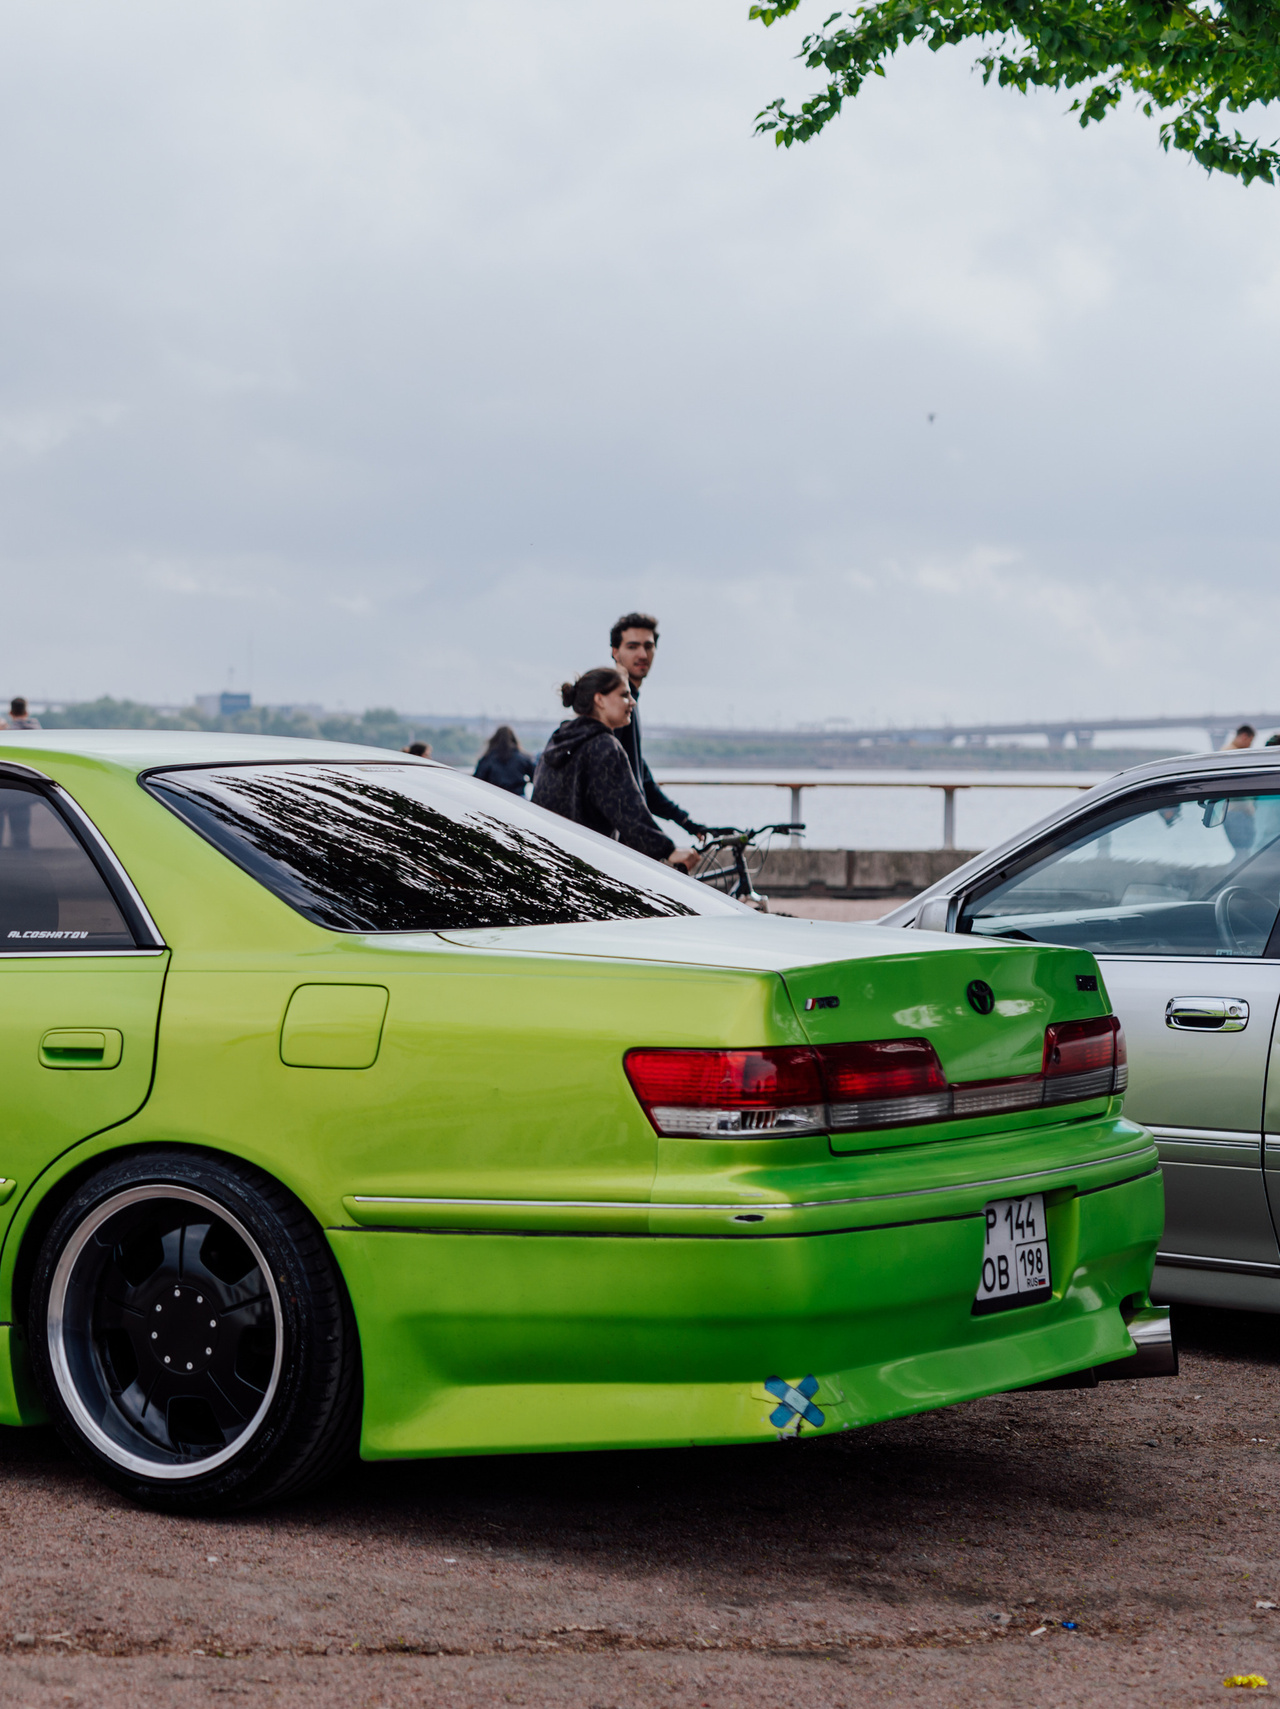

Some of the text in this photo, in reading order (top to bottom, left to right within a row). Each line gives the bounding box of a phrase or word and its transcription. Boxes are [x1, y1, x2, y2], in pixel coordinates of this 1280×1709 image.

[7, 930, 89, 939] ALCOSHATOV
[1004, 1201, 1036, 1241] 144
[1019, 1247, 1044, 1277] 198
[1026, 1278, 1039, 1288] RUS
